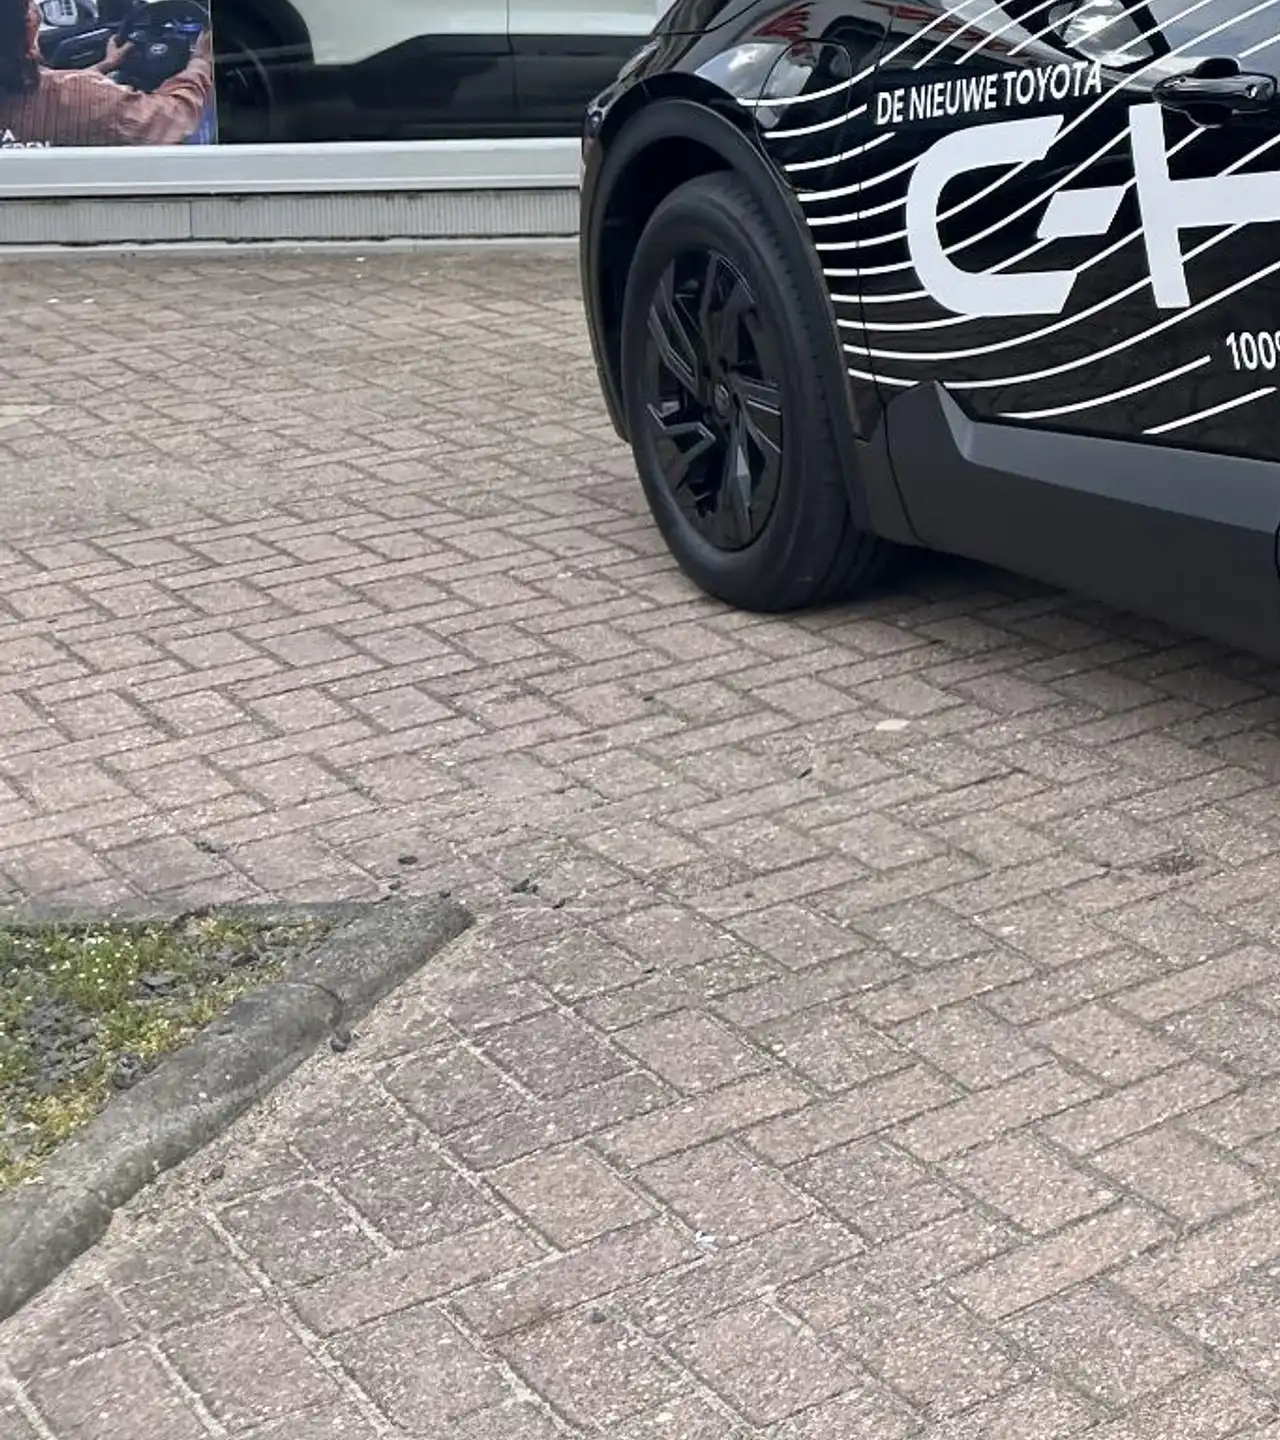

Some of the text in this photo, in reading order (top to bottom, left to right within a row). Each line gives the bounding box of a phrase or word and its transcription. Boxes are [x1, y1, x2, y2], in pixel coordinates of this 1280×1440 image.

[875, 59, 1102, 126] DE NIEUWE TOYOTA
